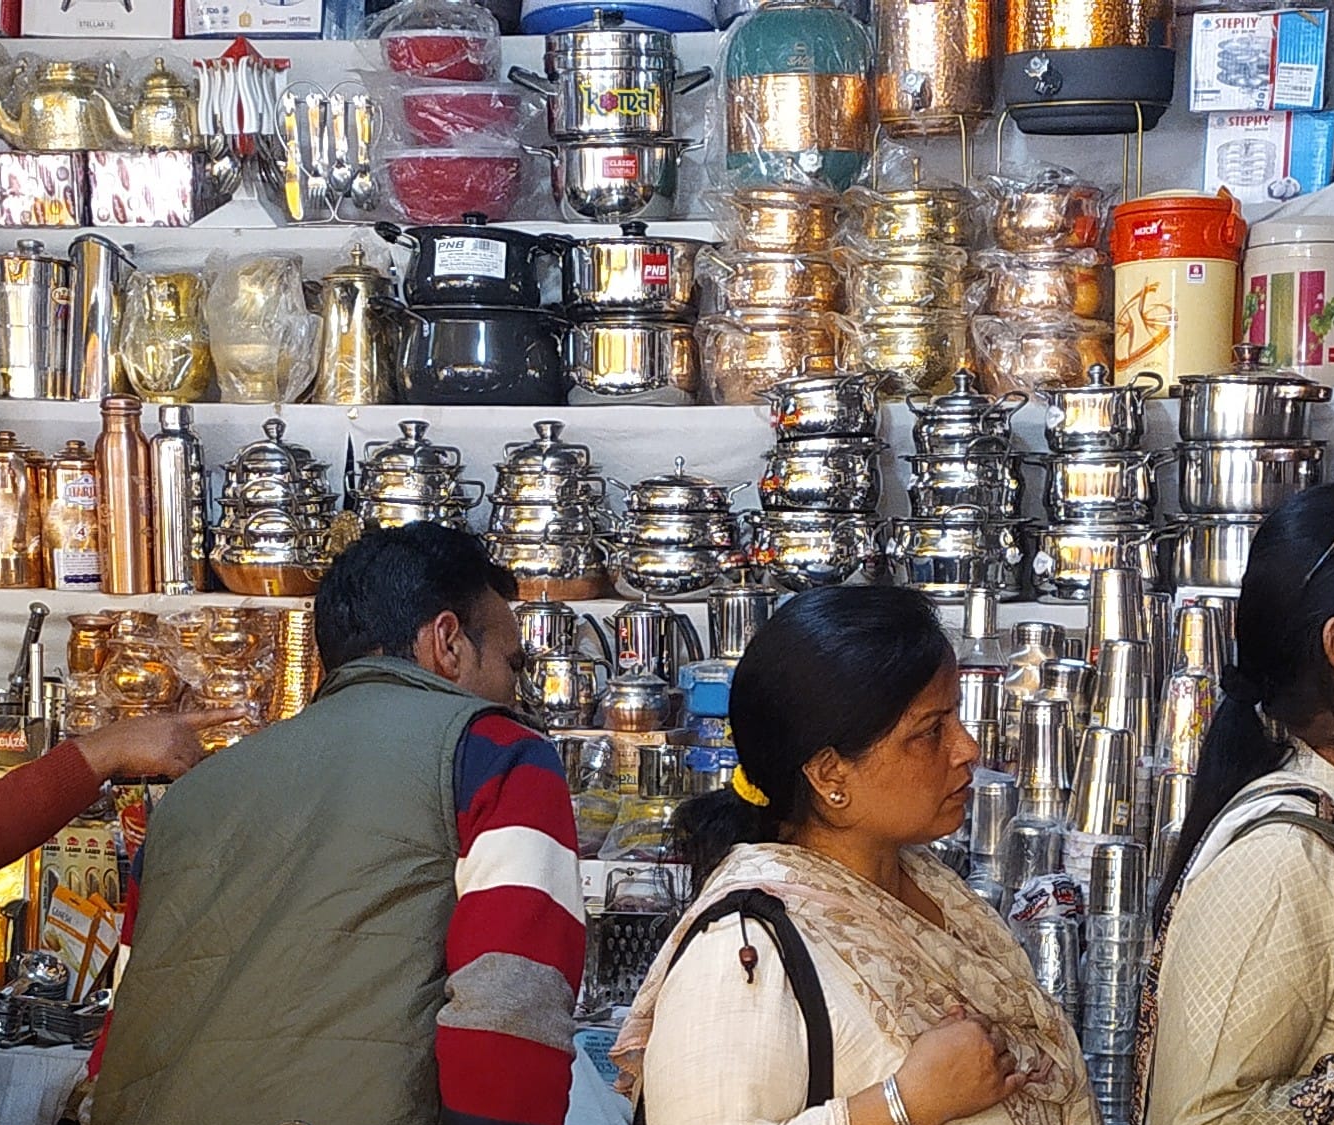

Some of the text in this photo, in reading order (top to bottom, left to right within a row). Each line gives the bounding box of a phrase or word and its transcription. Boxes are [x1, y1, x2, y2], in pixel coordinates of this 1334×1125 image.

[1228, 115, 1272, 127] STEPHY
[437, 241, 465, 251] PNB
[644, 265, 666, 277] PNB
